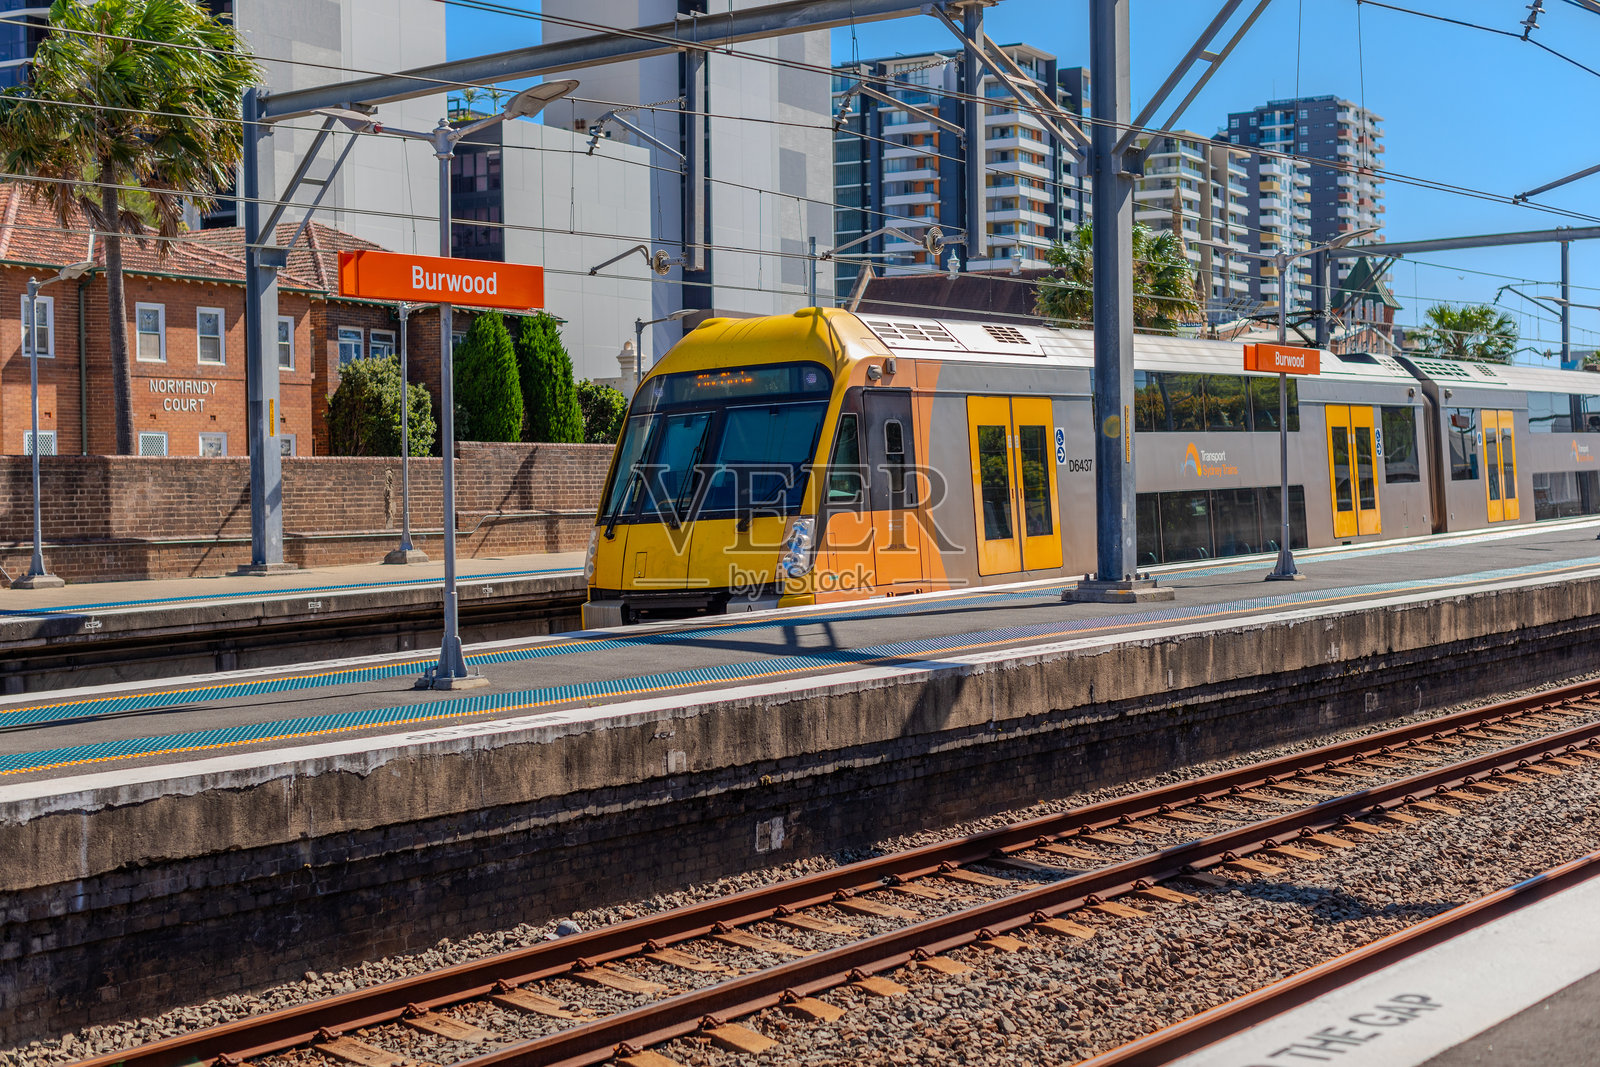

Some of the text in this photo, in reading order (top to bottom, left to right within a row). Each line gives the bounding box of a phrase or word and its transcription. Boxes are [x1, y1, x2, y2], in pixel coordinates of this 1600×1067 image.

[412, 265, 497, 295] Burwood
[1275, 351, 1305, 368] Burwood
[149, 379, 217, 394] NORMANDY
[163, 398, 205, 412] COURT
[1200, 450, 1226, 463] Transport
[1068, 459, 1093, 473] D6437
[1202, 464, 1222, 478] Sydney
[1267, 993, 1442, 1061] THE GAP
